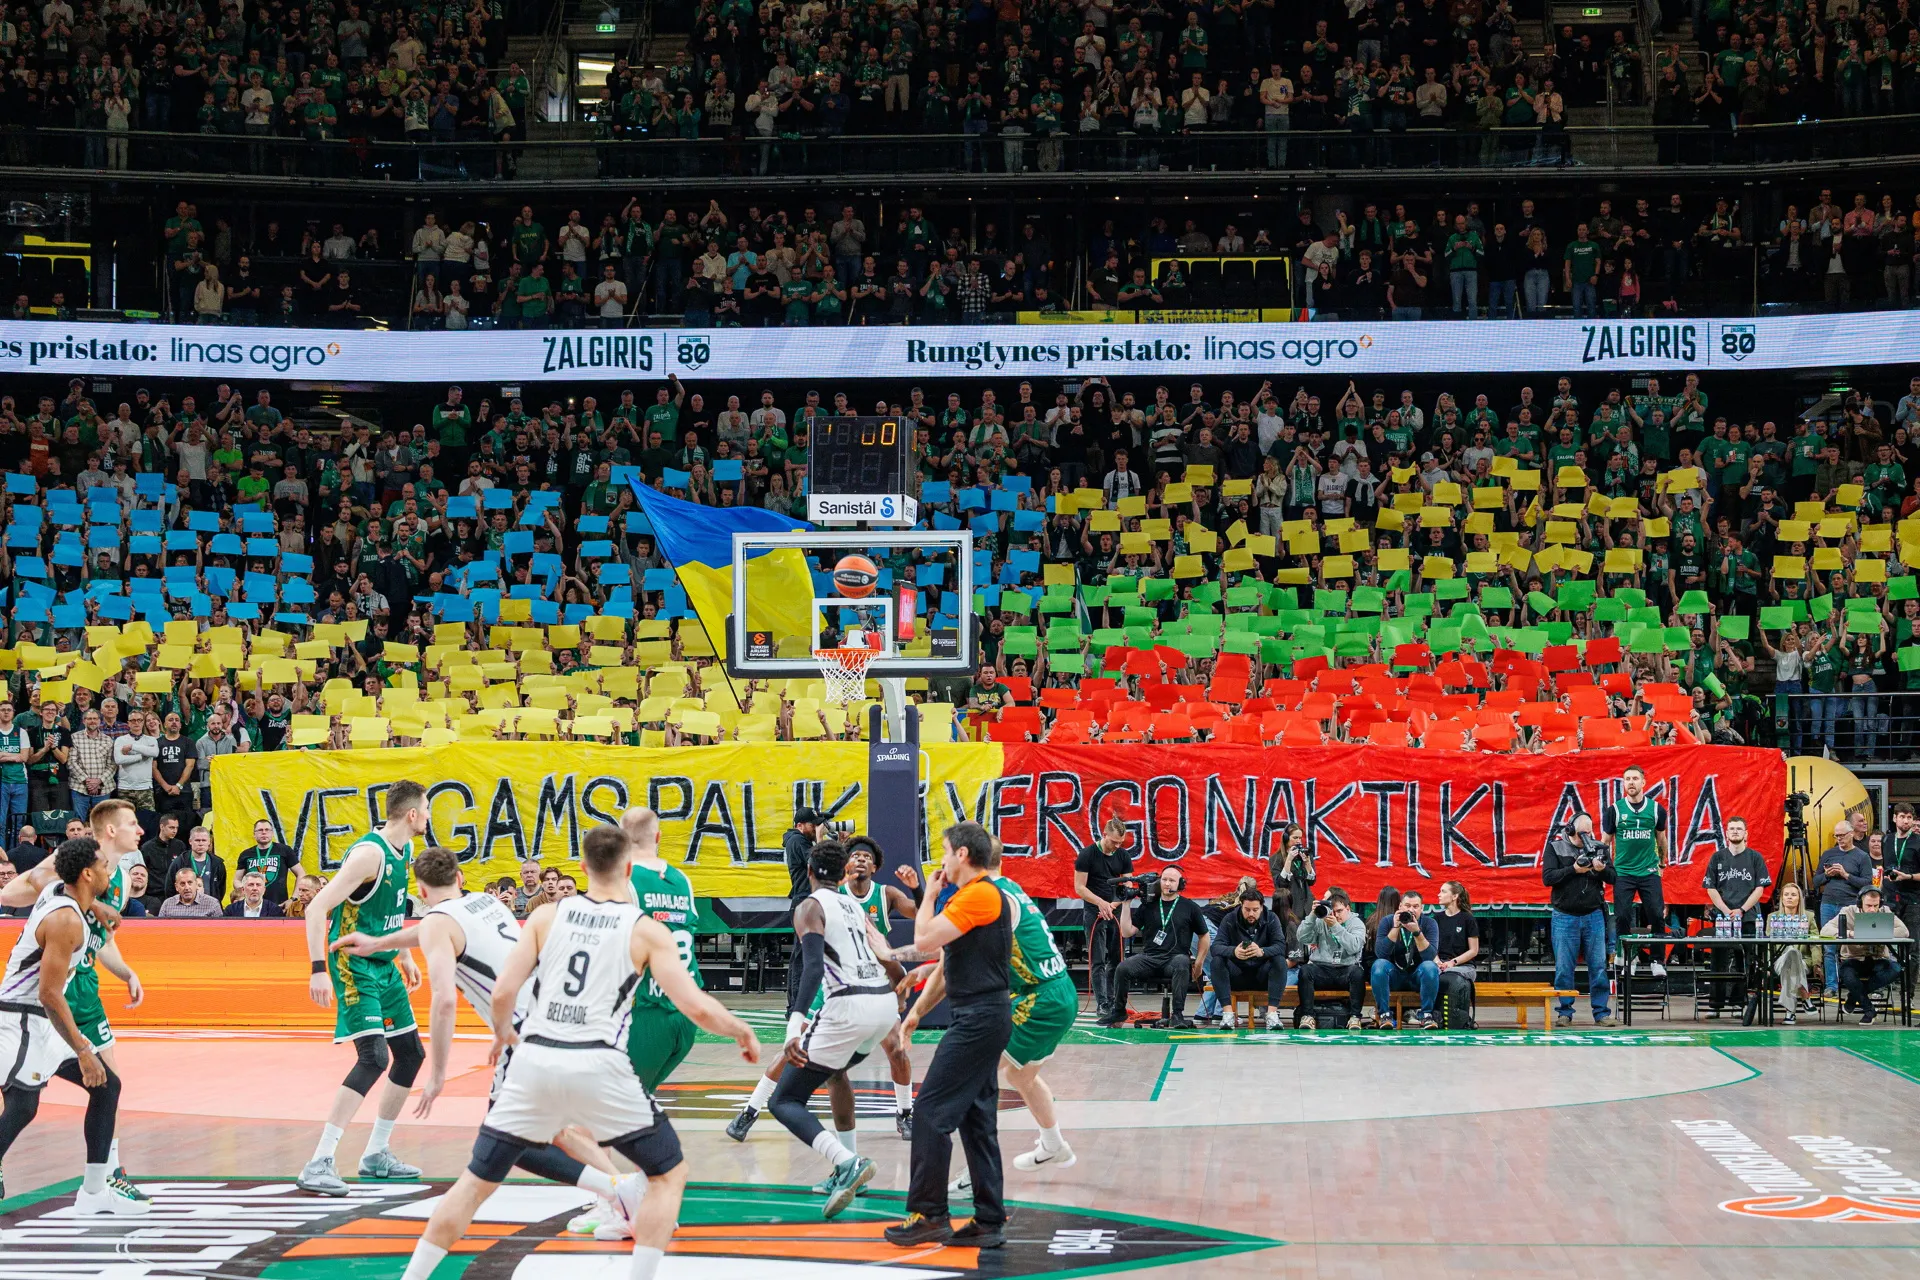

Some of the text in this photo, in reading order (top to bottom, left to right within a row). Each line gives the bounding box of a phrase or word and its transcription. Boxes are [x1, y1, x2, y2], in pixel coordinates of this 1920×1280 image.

[30, 335, 157, 366] pristato:
[171, 337, 326, 372] linas agro
[678, 343, 710, 364] 80
[906, 336, 1191, 370] Rungtynes pristato:
[1204, 335, 1358, 367] linas agro
[1721, 333, 1756, 354] 80
[819, 499, 876, 515] Sanistål
[162, 746, 181, 756] GAP
[877, 753, 910, 763] SPALDING
[570, 931, 600, 945] mts
[563, 950, 591, 997] 9
[547, 1001, 589, 1025] BELGRADE
